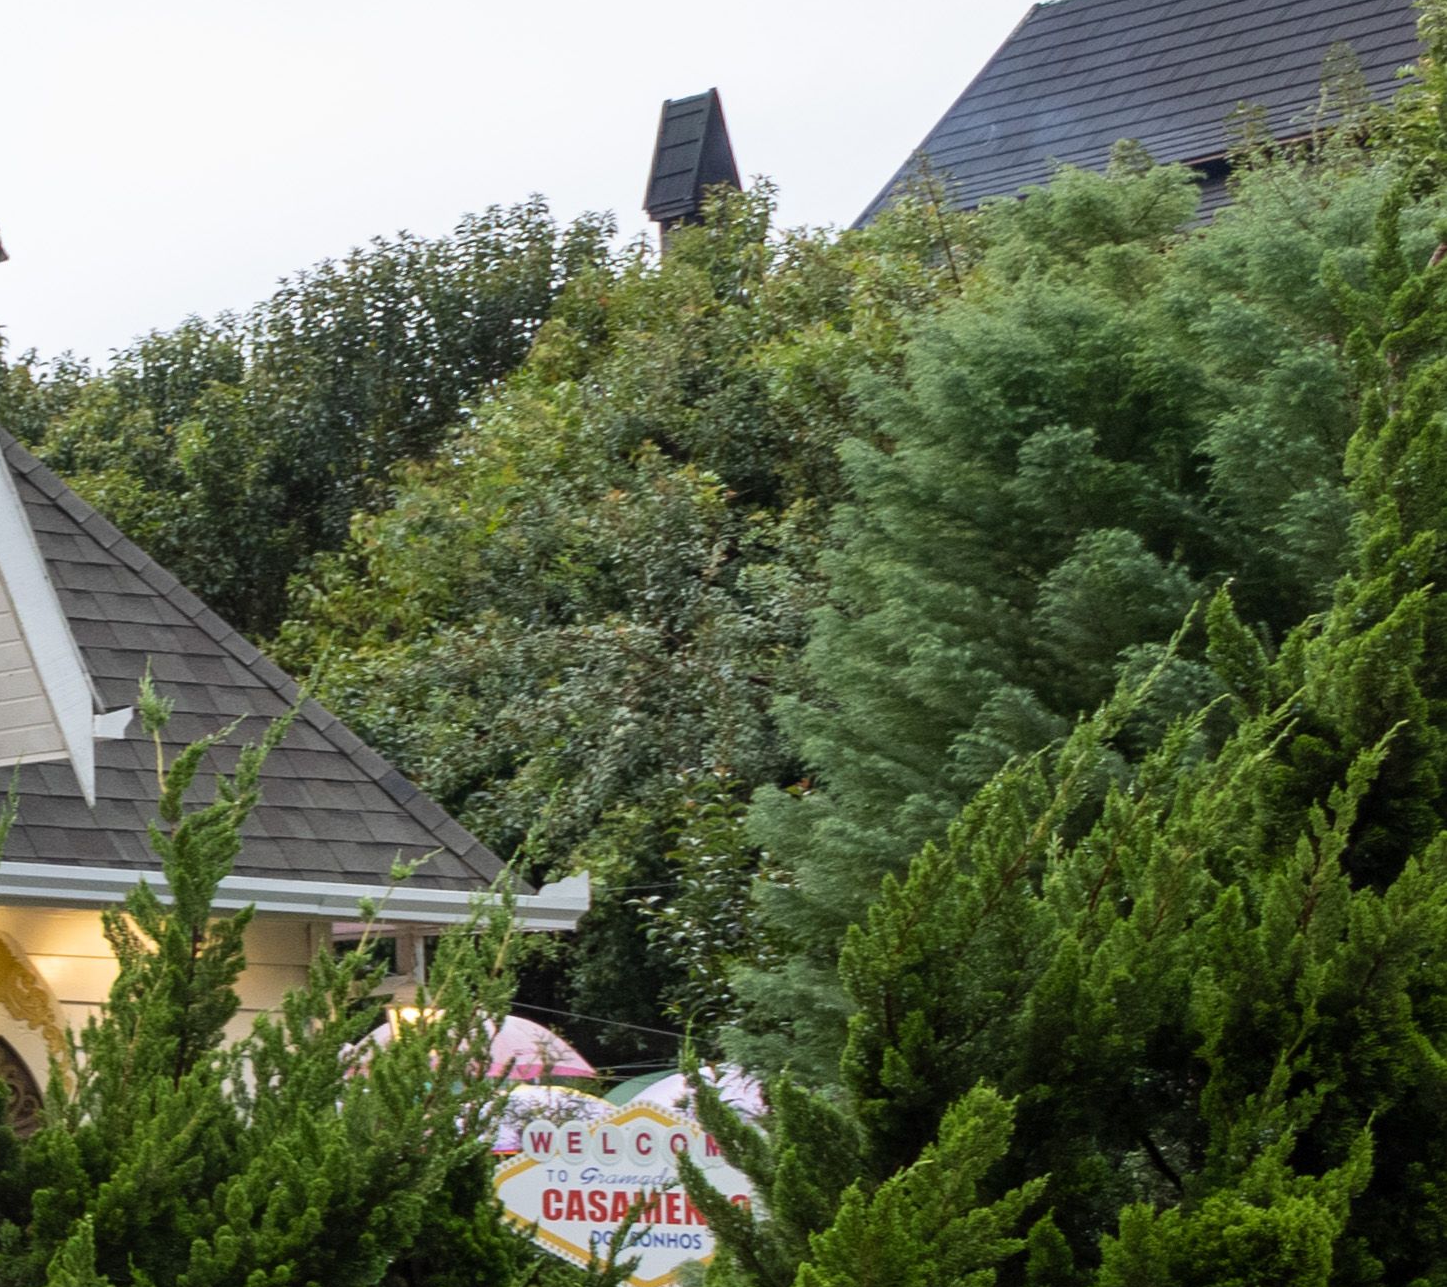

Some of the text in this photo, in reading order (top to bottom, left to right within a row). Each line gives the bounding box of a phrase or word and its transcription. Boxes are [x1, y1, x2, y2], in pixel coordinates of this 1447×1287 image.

[530, 1131, 722, 1157] WELCOM
[546, 1169, 568, 1183] TO
[542, 1188, 751, 1226] CASAMEN
